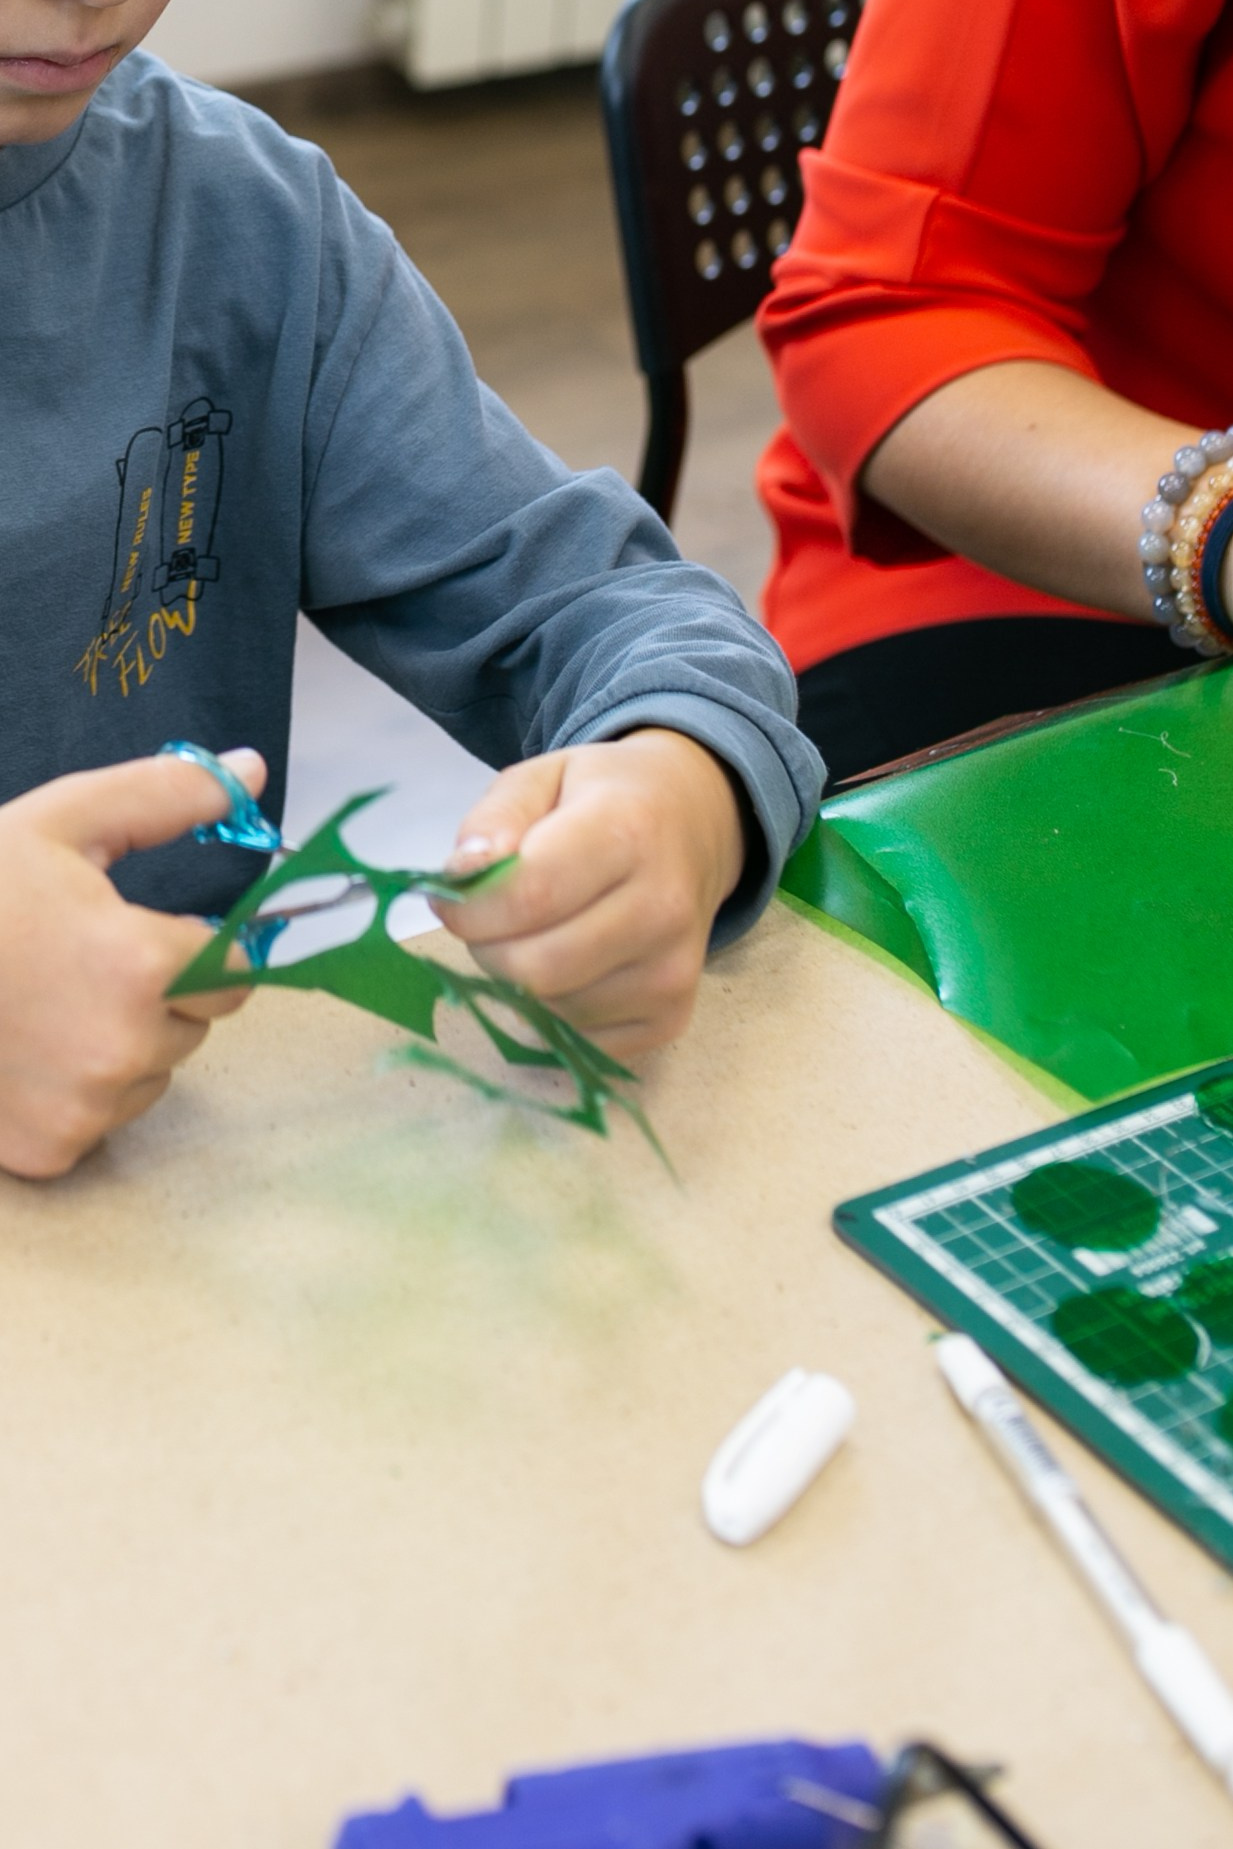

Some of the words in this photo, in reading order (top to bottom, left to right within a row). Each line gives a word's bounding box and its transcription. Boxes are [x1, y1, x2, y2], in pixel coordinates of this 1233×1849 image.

[181, 449, 201, 498] TYPE
[120, 551, 140, 594] NEW
[132, 486, 153, 547] RULES
[176, 500, 195, 545] NEW
[111, 579, 198, 698] FLOW
